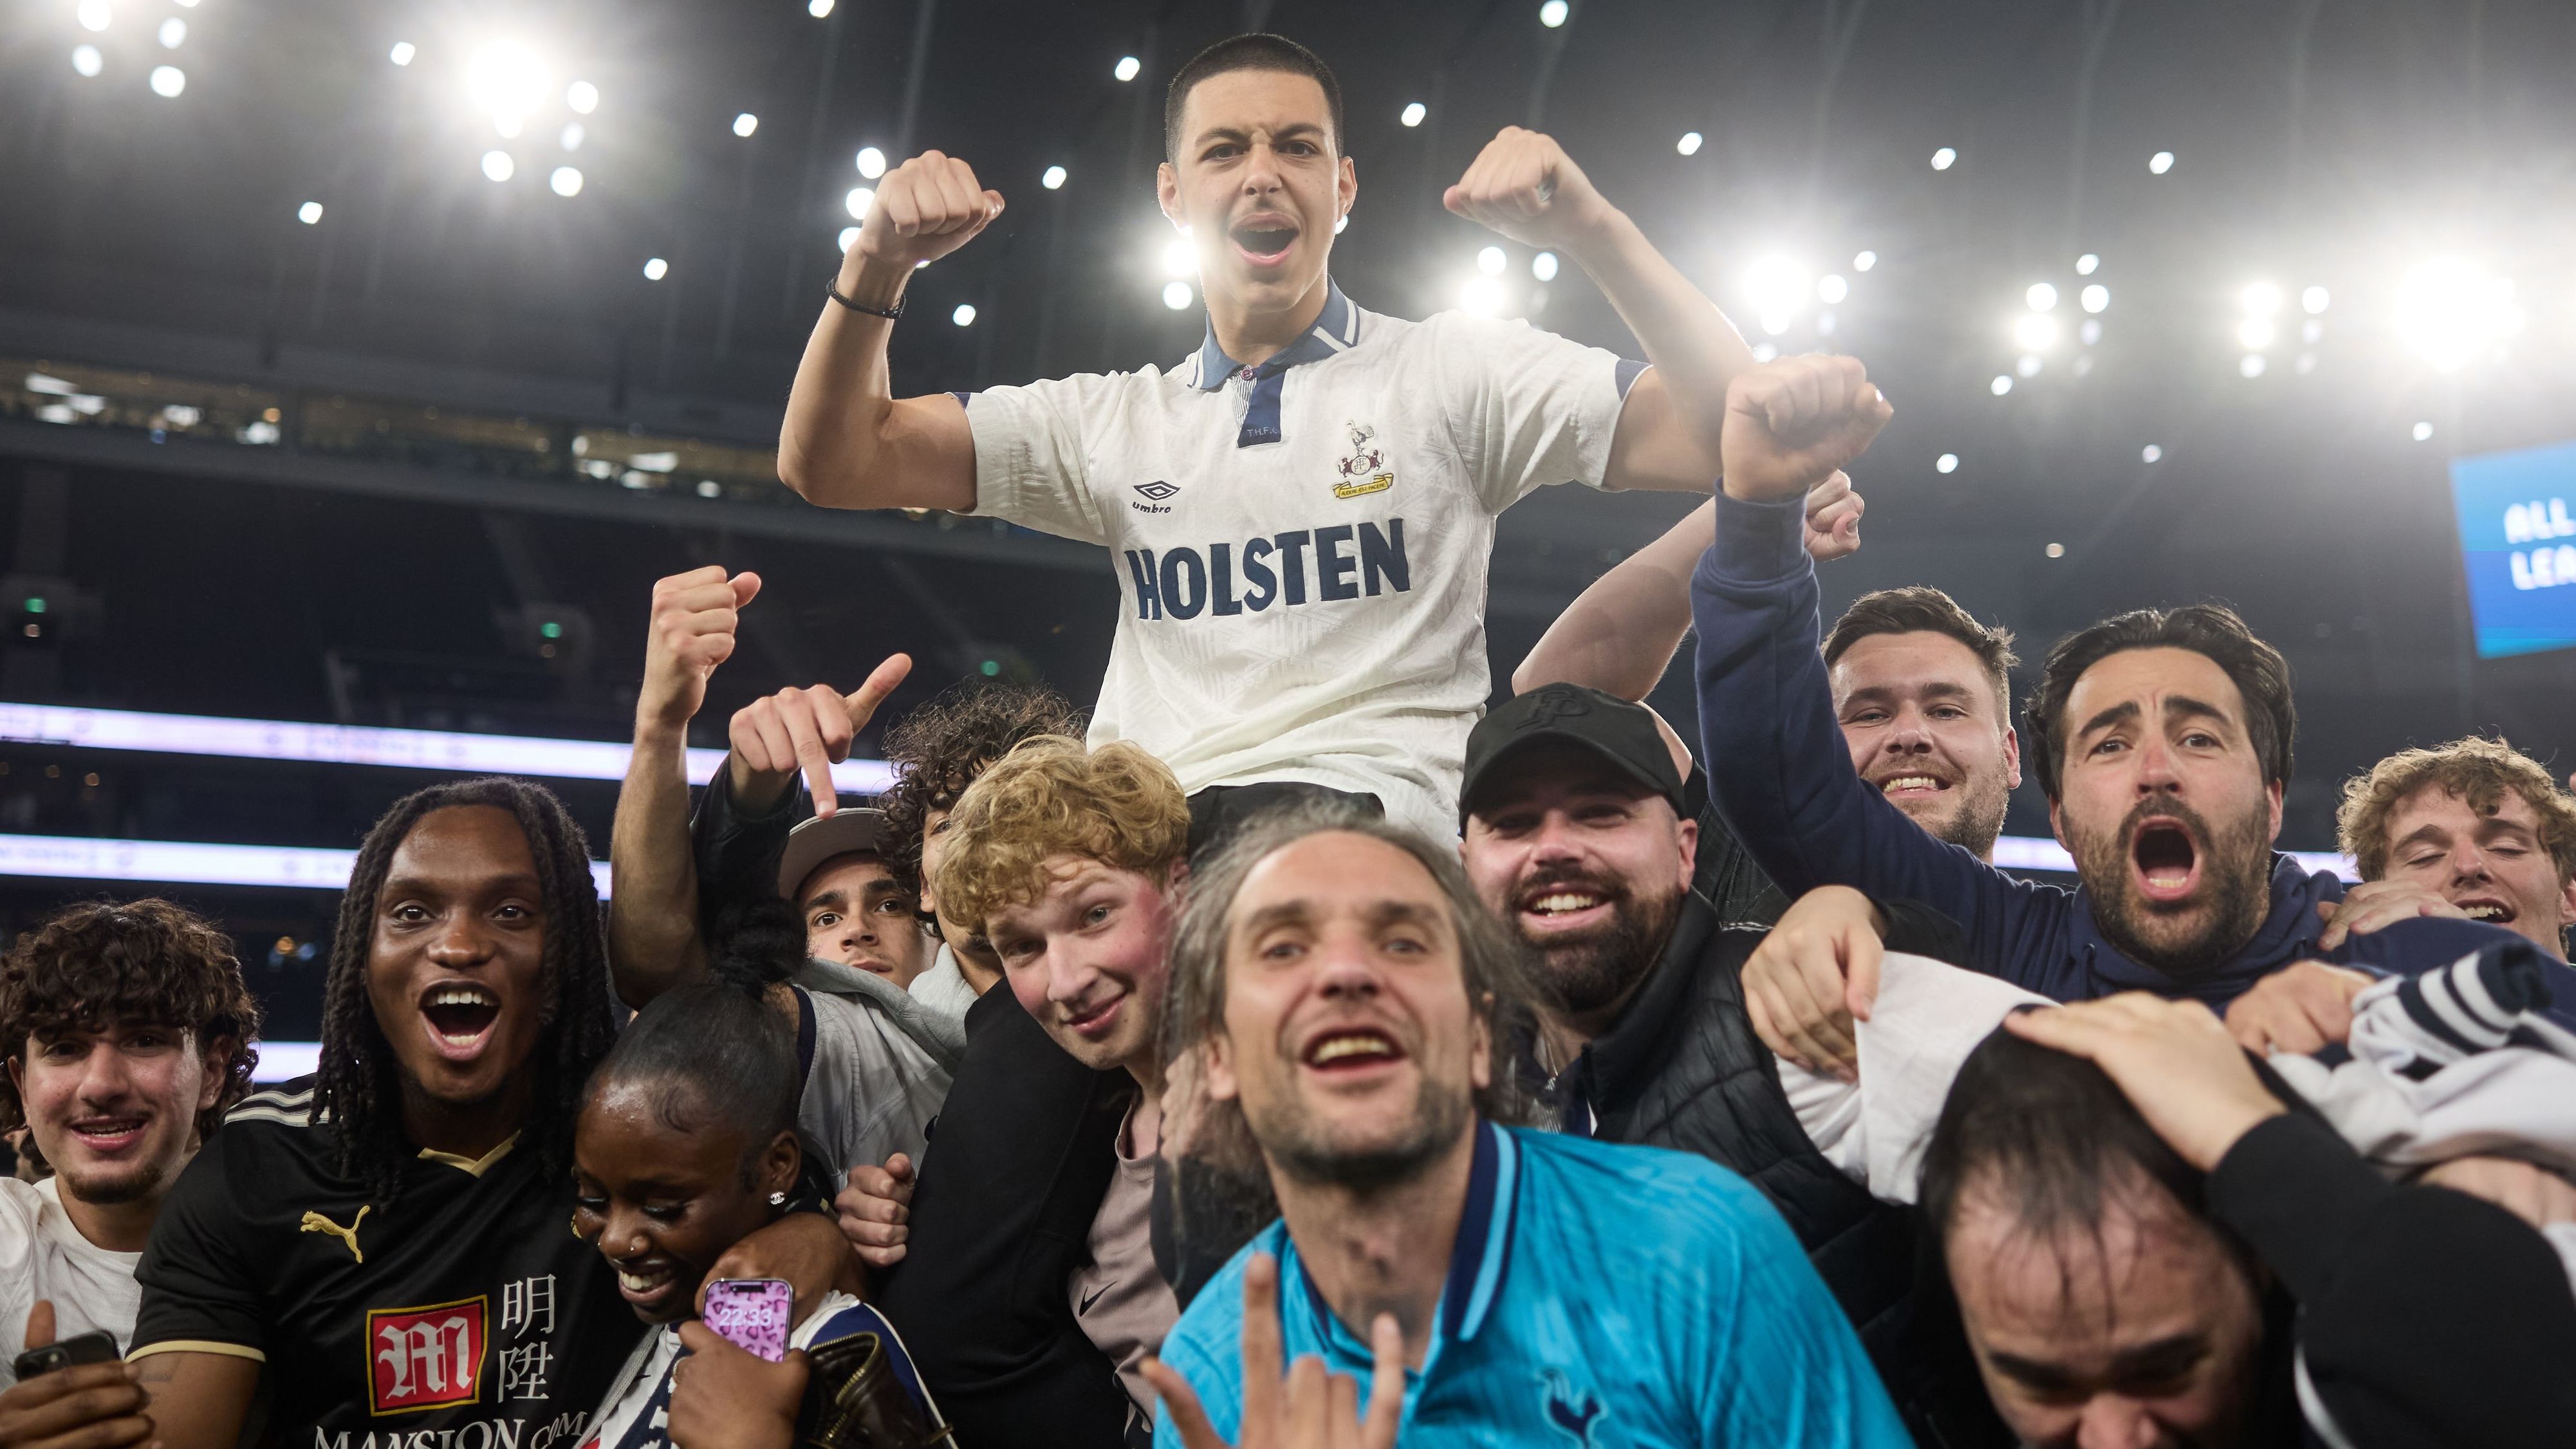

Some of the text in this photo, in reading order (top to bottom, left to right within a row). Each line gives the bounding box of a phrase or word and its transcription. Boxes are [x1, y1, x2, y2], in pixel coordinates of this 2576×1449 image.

[1132, 501, 1171, 513] umbro
[1124, 518, 1411, 620] HOLSTEN
[719, 1307, 773, 1327] 22:33
